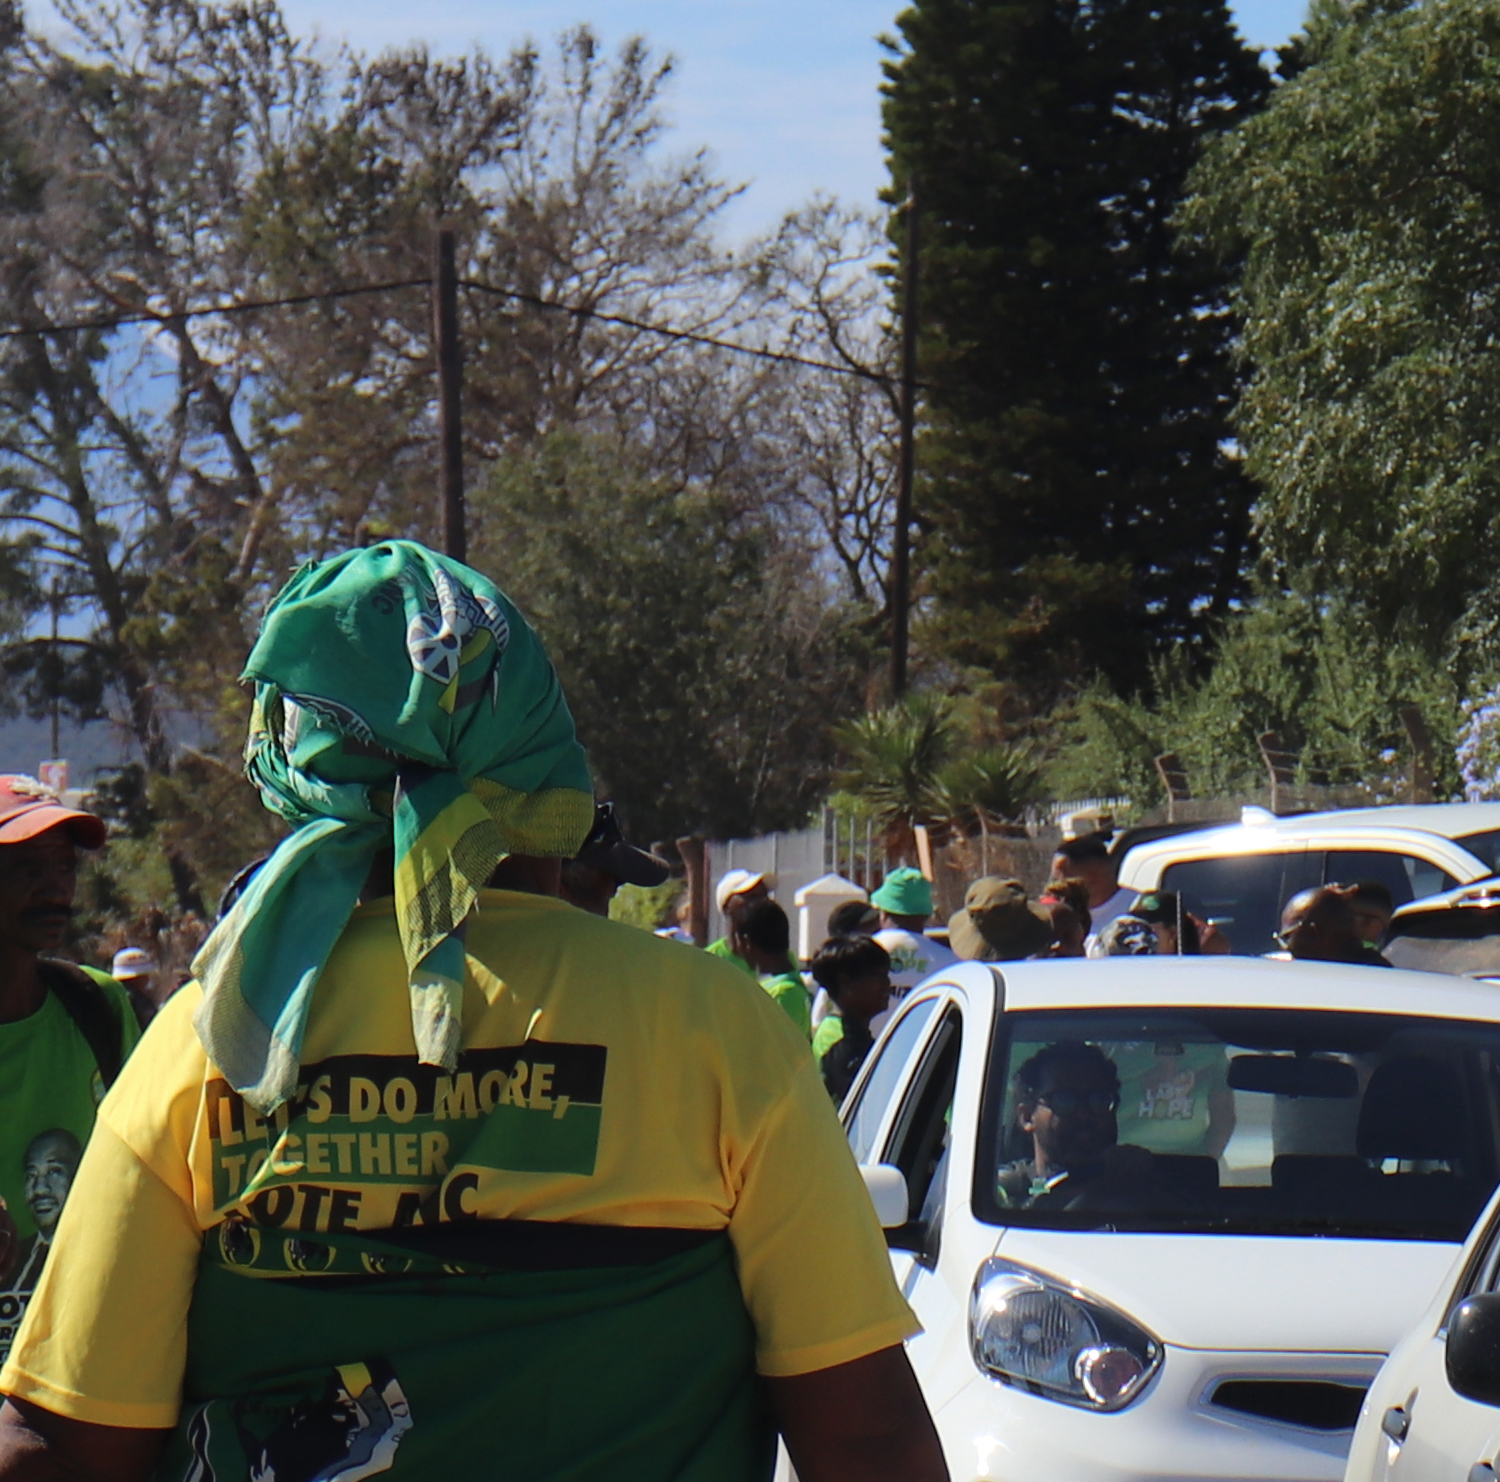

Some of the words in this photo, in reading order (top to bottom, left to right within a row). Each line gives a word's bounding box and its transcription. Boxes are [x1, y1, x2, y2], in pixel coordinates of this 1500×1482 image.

[349, 1076, 419, 1124] DO
[434, 1060, 572, 1121] MORE,
[241, 1184, 363, 1233] OTE
